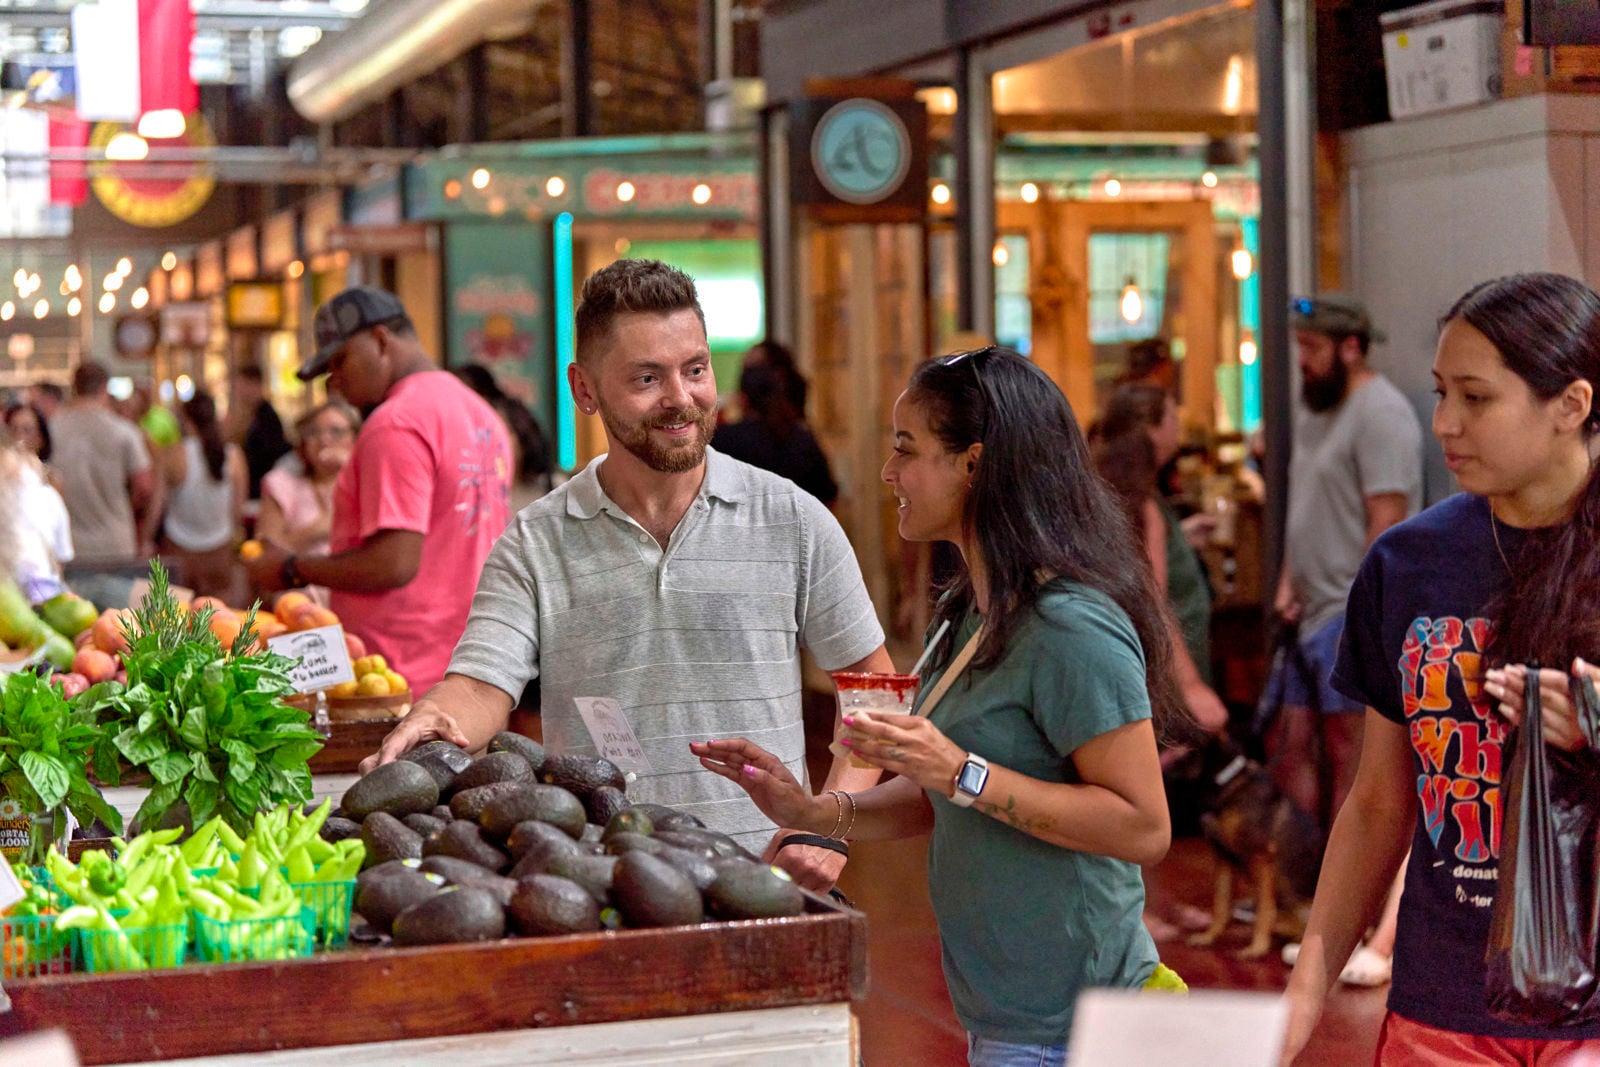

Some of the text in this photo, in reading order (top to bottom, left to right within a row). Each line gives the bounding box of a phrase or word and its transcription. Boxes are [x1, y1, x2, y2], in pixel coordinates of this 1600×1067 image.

[1402, 616, 1491, 654] sav
[1398, 647, 1490, 720] liv
[0, 829, 29, 839] ORTAL
[0, 838, 30, 848] LOOM
[1453, 864, 1499, 880] donat
